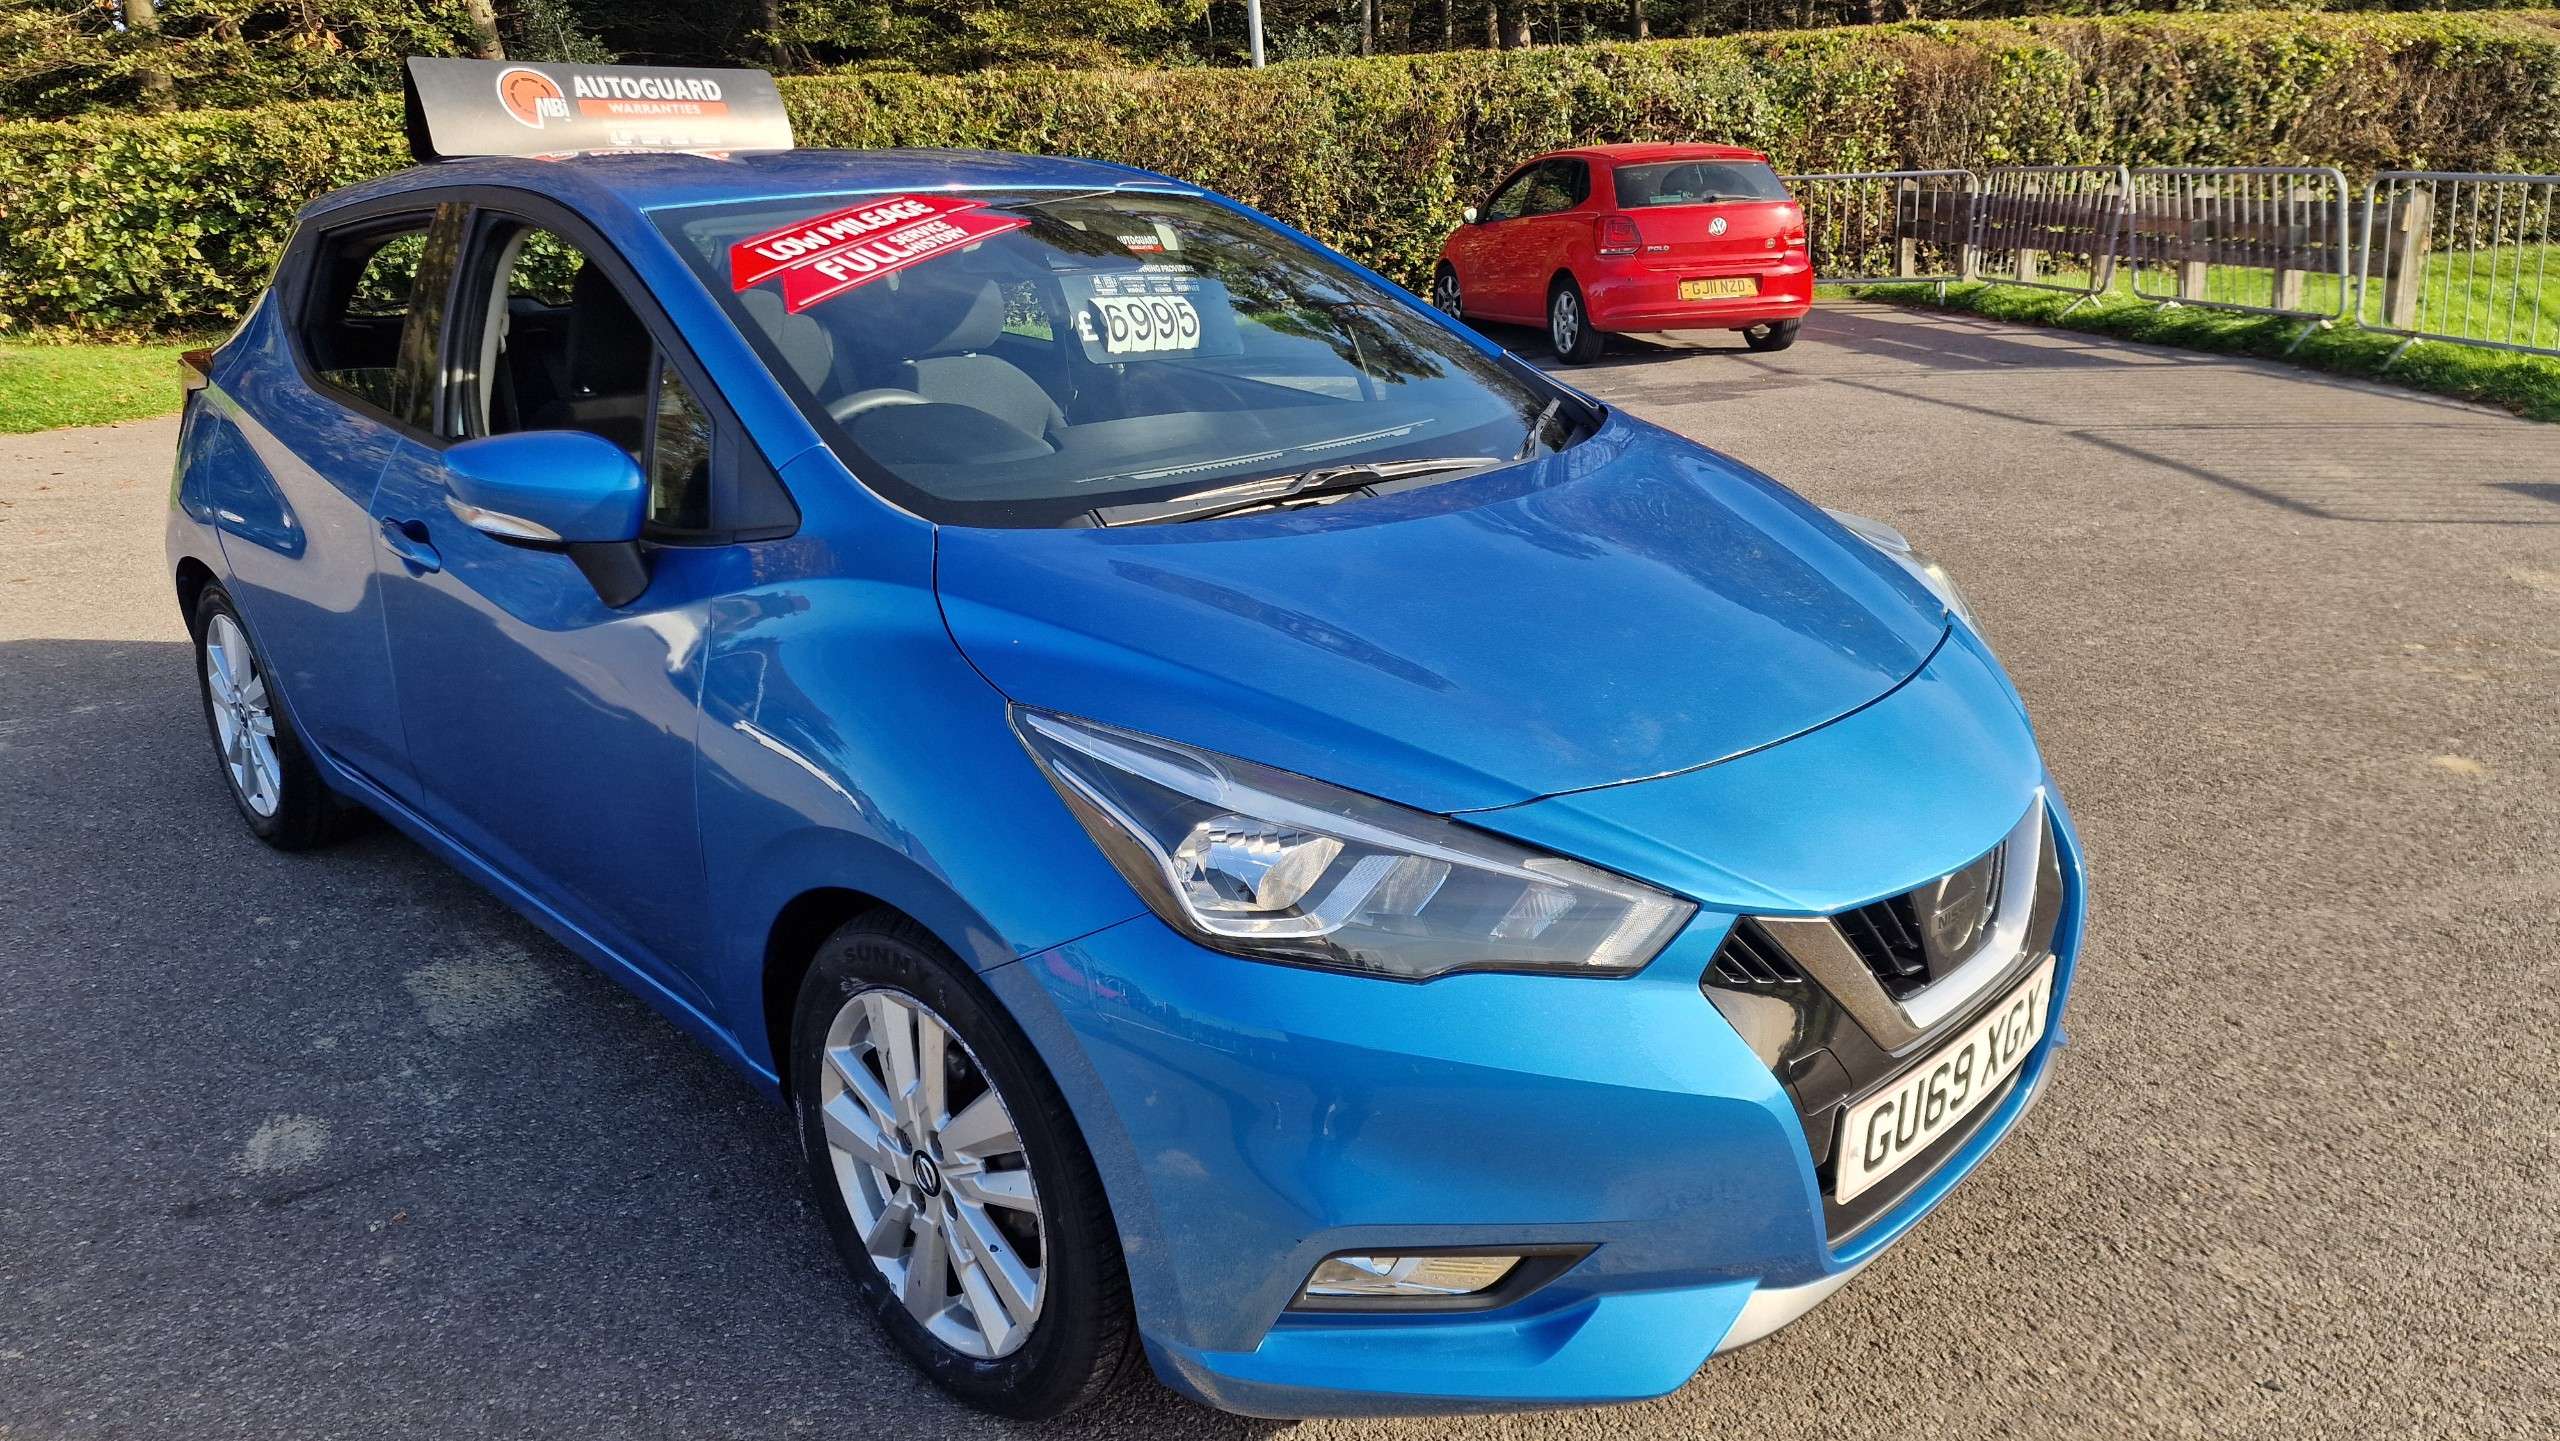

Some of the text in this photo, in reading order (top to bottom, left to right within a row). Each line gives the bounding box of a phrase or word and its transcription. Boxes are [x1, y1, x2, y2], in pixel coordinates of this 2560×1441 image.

[573, 75, 722, 101] AUTOGUARD
[607, 103, 702, 115] WARRANTIES
[755, 199, 935, 261] LOW MILEAGE
[887, 220, 952, 246] SERVICE
[903, 226, 970, 254] HISTORY
[814, 241, 916, 281] FULL
[1078, 302, 1198, 343] £ 6995
[1863, 983, 2042, 1173] GU69 XGX
